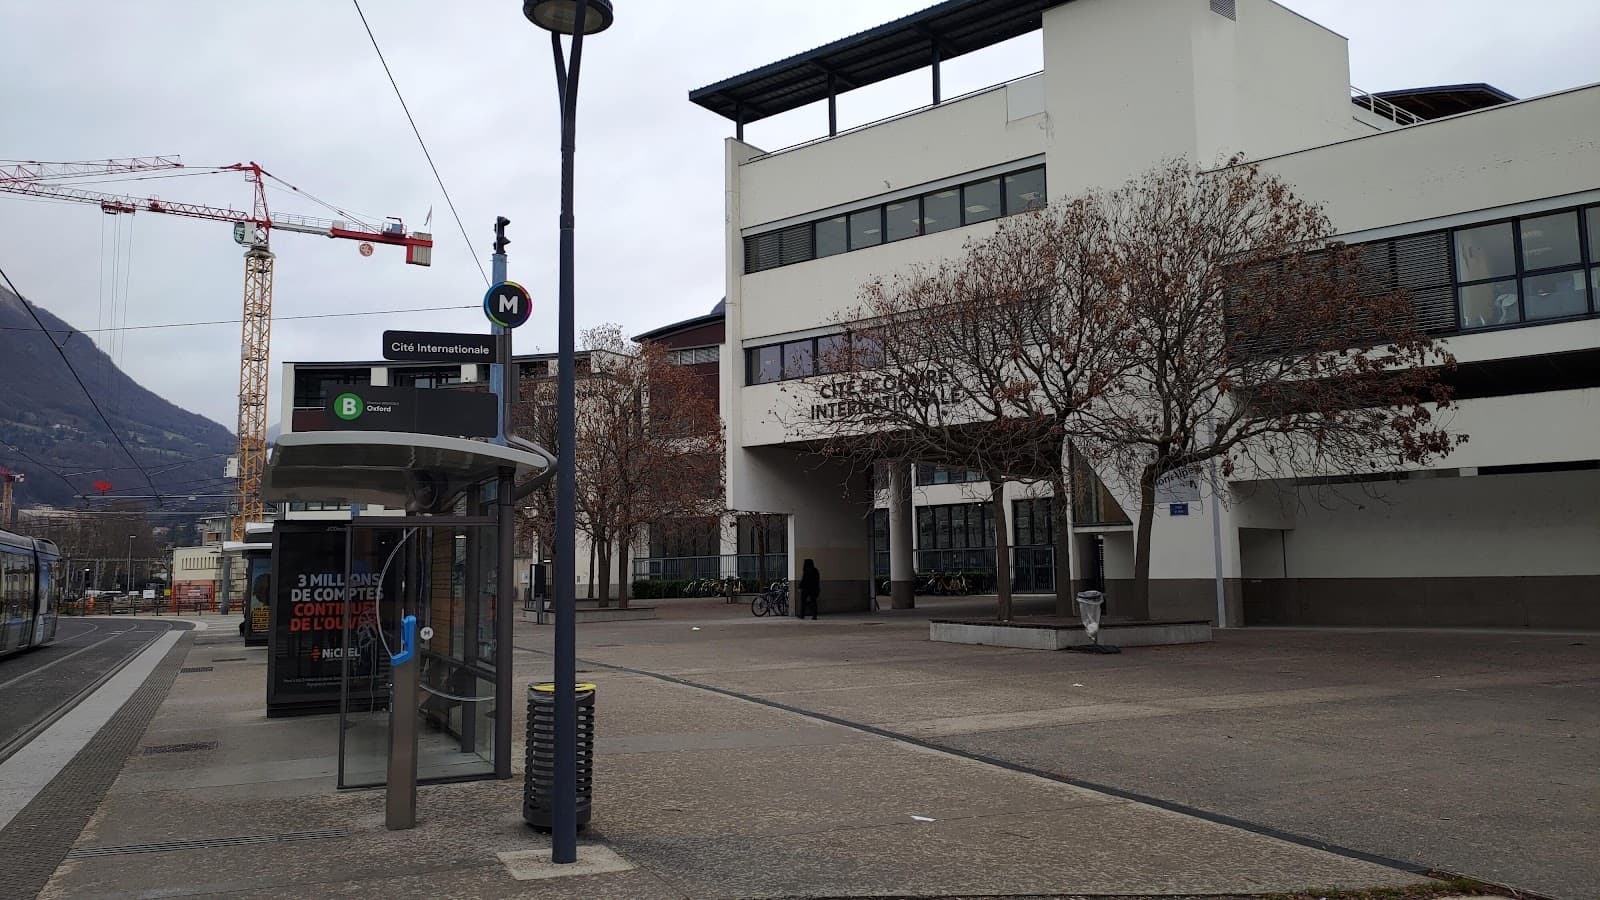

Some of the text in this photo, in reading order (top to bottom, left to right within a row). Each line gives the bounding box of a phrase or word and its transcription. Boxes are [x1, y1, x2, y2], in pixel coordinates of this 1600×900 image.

[499, 295, 518, 314] M
[391, 342, 490, 355] Cité Internationale
[342, 397, 357, 416] B
[366, 405, 392, 413] Oxford
[298, 572, 381, 588] 3 MILLONS
[291, 588, 311, 602] DE
[294, 602, 378, 617] CONTIUE
[290, 618, 310, 632] DE
[322, 647, 361, 659] NiCEL
